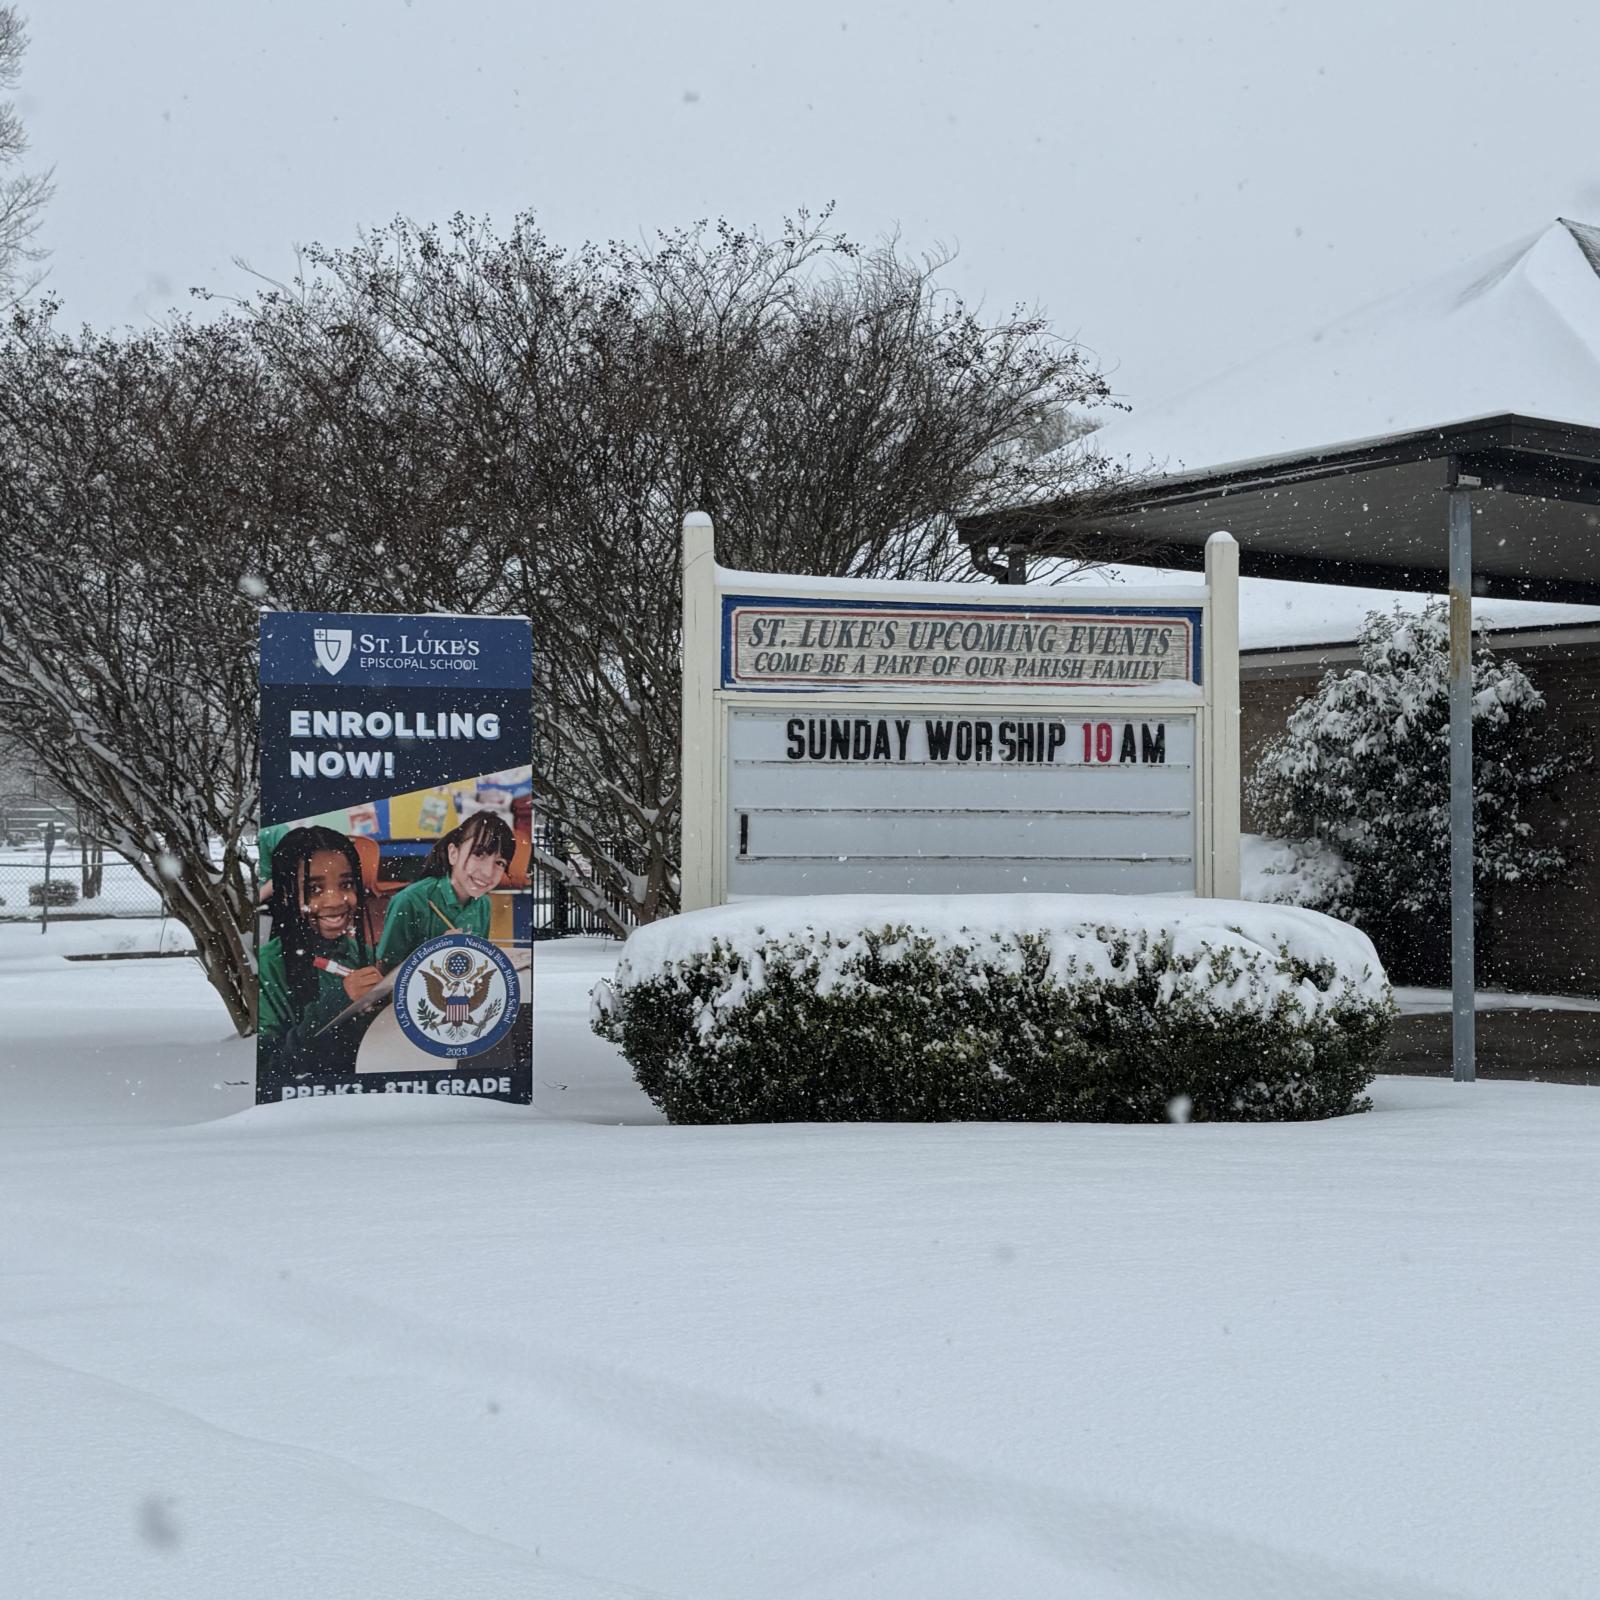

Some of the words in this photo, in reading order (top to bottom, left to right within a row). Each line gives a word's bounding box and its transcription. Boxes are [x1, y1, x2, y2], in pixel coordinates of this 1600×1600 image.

[748, 618, 788, 648] ST.
[800, 619, 899, 649] LUKE'S
[908, 621, 1058, 654] UPCOMING
[1064, 625, 1173, 656] EVENTS
[360, 657, 427, 670] EPISCOPAL
[430, 659, 479, 671] SCHOOL
[754, 652, 813, 673] COME
[820, 653, 848, 674] BE
[852, 655, 866, 674] A
[872, 655, 927, 675] PART
[932, 656, 960, 676] OF
[965, 656, 1007, 677] OUR
[1012, 657, 1086, 679] PARISH
[1089, 660, 1165, 680] FAMILY
[290, 710, 500, 740] ENROLLING
[786, 718, 911, 761] SUNDAY
[925, 720, 1066, 763] WORSHIP
[1083, 722, 1113, 763] 10
[1119, 723, 1166, 764] AM
[290, 751, 395, 778] NOW!
[396, 967, 412, 1010] Department
[416, 939, 454, 960] Education
[464, 937, 495, 957] National
[503, 968, 516, 997] Ribbon
[384, 1080, 428, 1095] 8TH
[435, 1077, 512, 1095] GRADE
